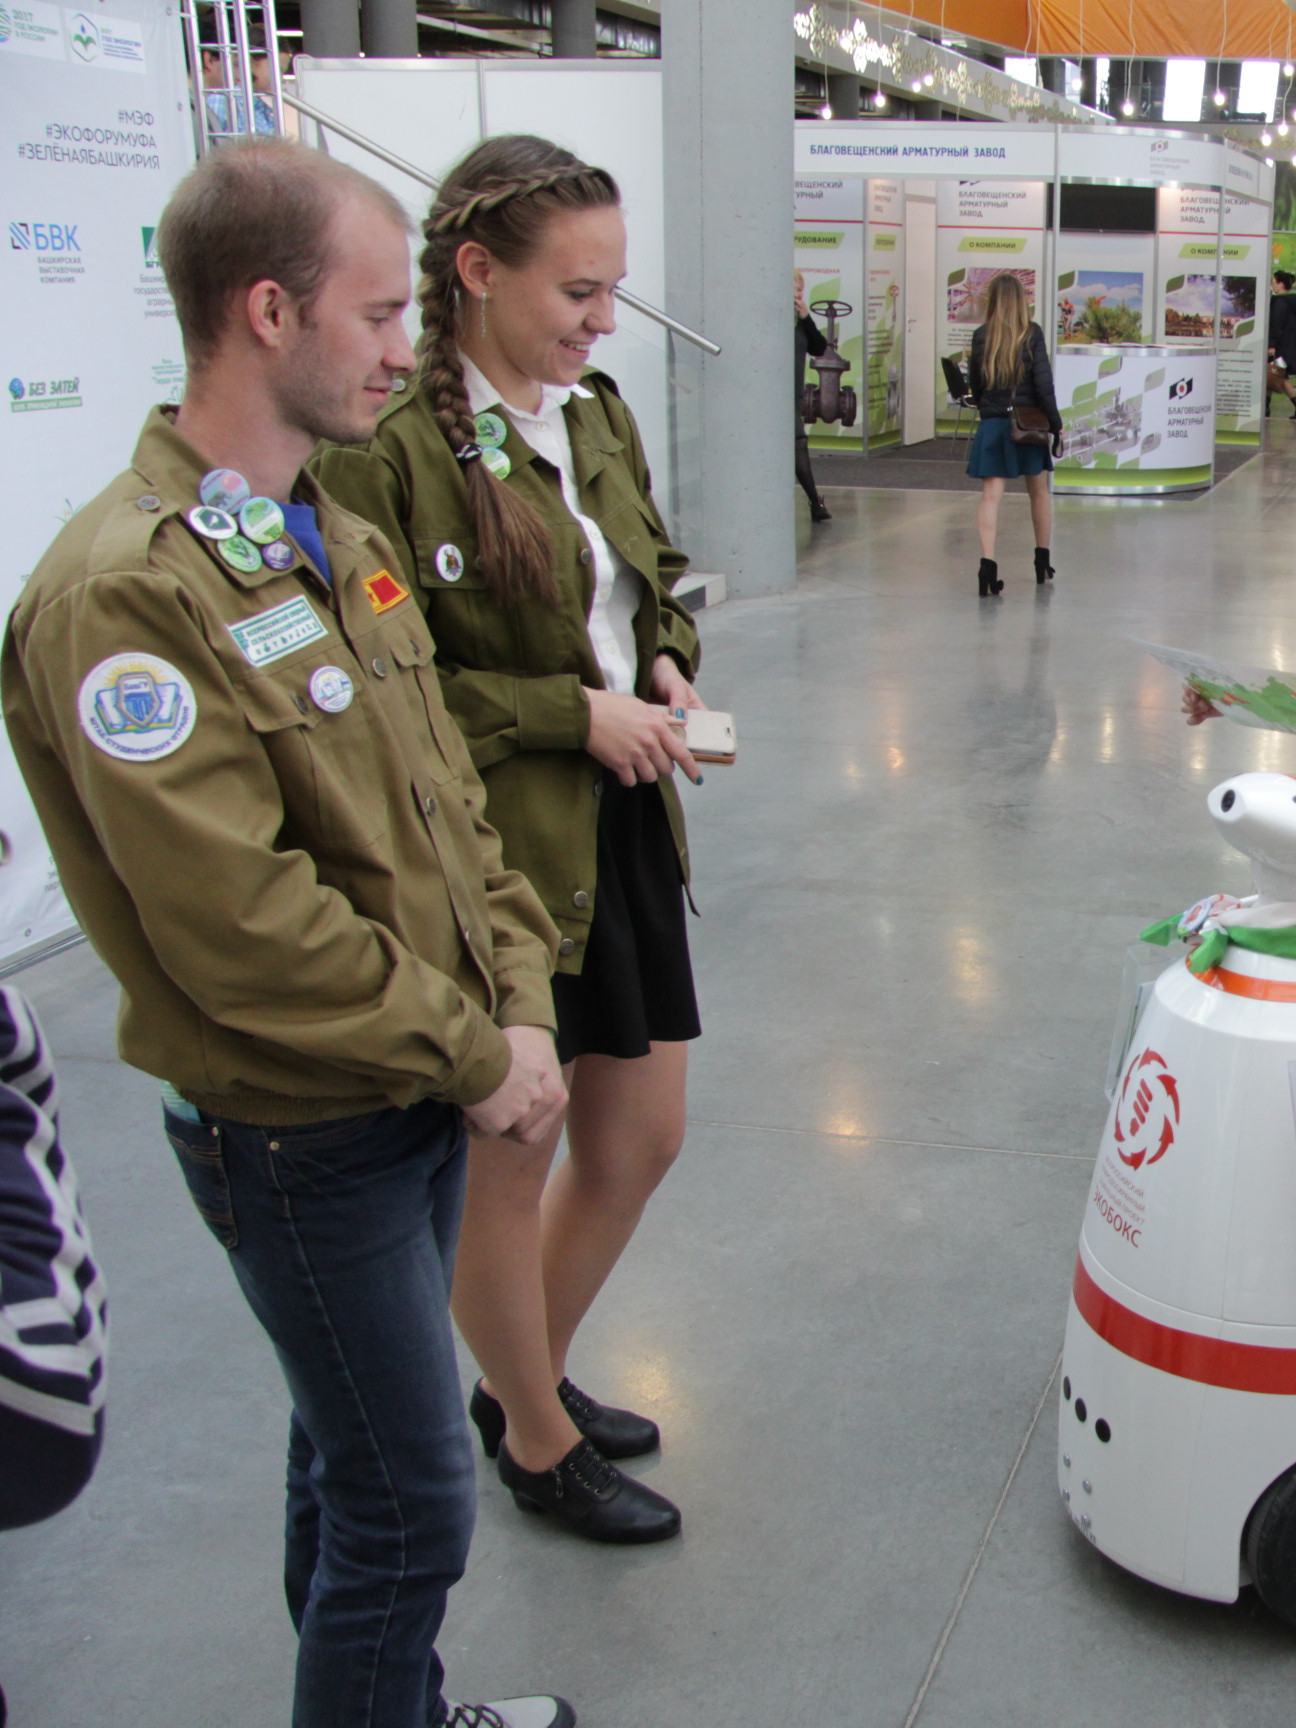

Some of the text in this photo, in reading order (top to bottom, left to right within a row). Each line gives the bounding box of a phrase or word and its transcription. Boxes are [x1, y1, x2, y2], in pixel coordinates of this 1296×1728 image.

[118, 109, 155, 126] #МЭФ
[46, 123, 158, 149] #ЭКОФОРУМУФА
[18, 143, 161, 170] #ЗЕЛЁНАЯБАШКИРИЯ
[810, 144, 1006, 159] БЛАГОВЕЩЕНСКИЙ АРМАТУРНЫЙ ЗАВОД
[959, 190, 1027, 199] БЛАГОВЕЩЕНСКИЙ
[959, 199, 1008, 208] АРМАТУРНЫЙ
[1180, 196, 1250, 206] БЛАГОВЕЩНСКИЙ
[959, 209, 983, 218] ЗАВОД
[1180, 206, 1231, 214] АРМАТУРНЙ
[1181, 216, 1205, 224] ЗАВОД
[33, 223, 82, 251] БВК
[976, 242, 1016, 250] КОМПАНИИ
[1197, 248, 1239, 256] КОМПНИИ
[29, 382, 46, 397] БЕЗ
[1167, 417, 1204, 427] АРМАТУРНЫЙ
[1167, 430, 1188, 438] ЗАВОД
[1094, 1184, 1142, 1248] ЭКОБОКС
